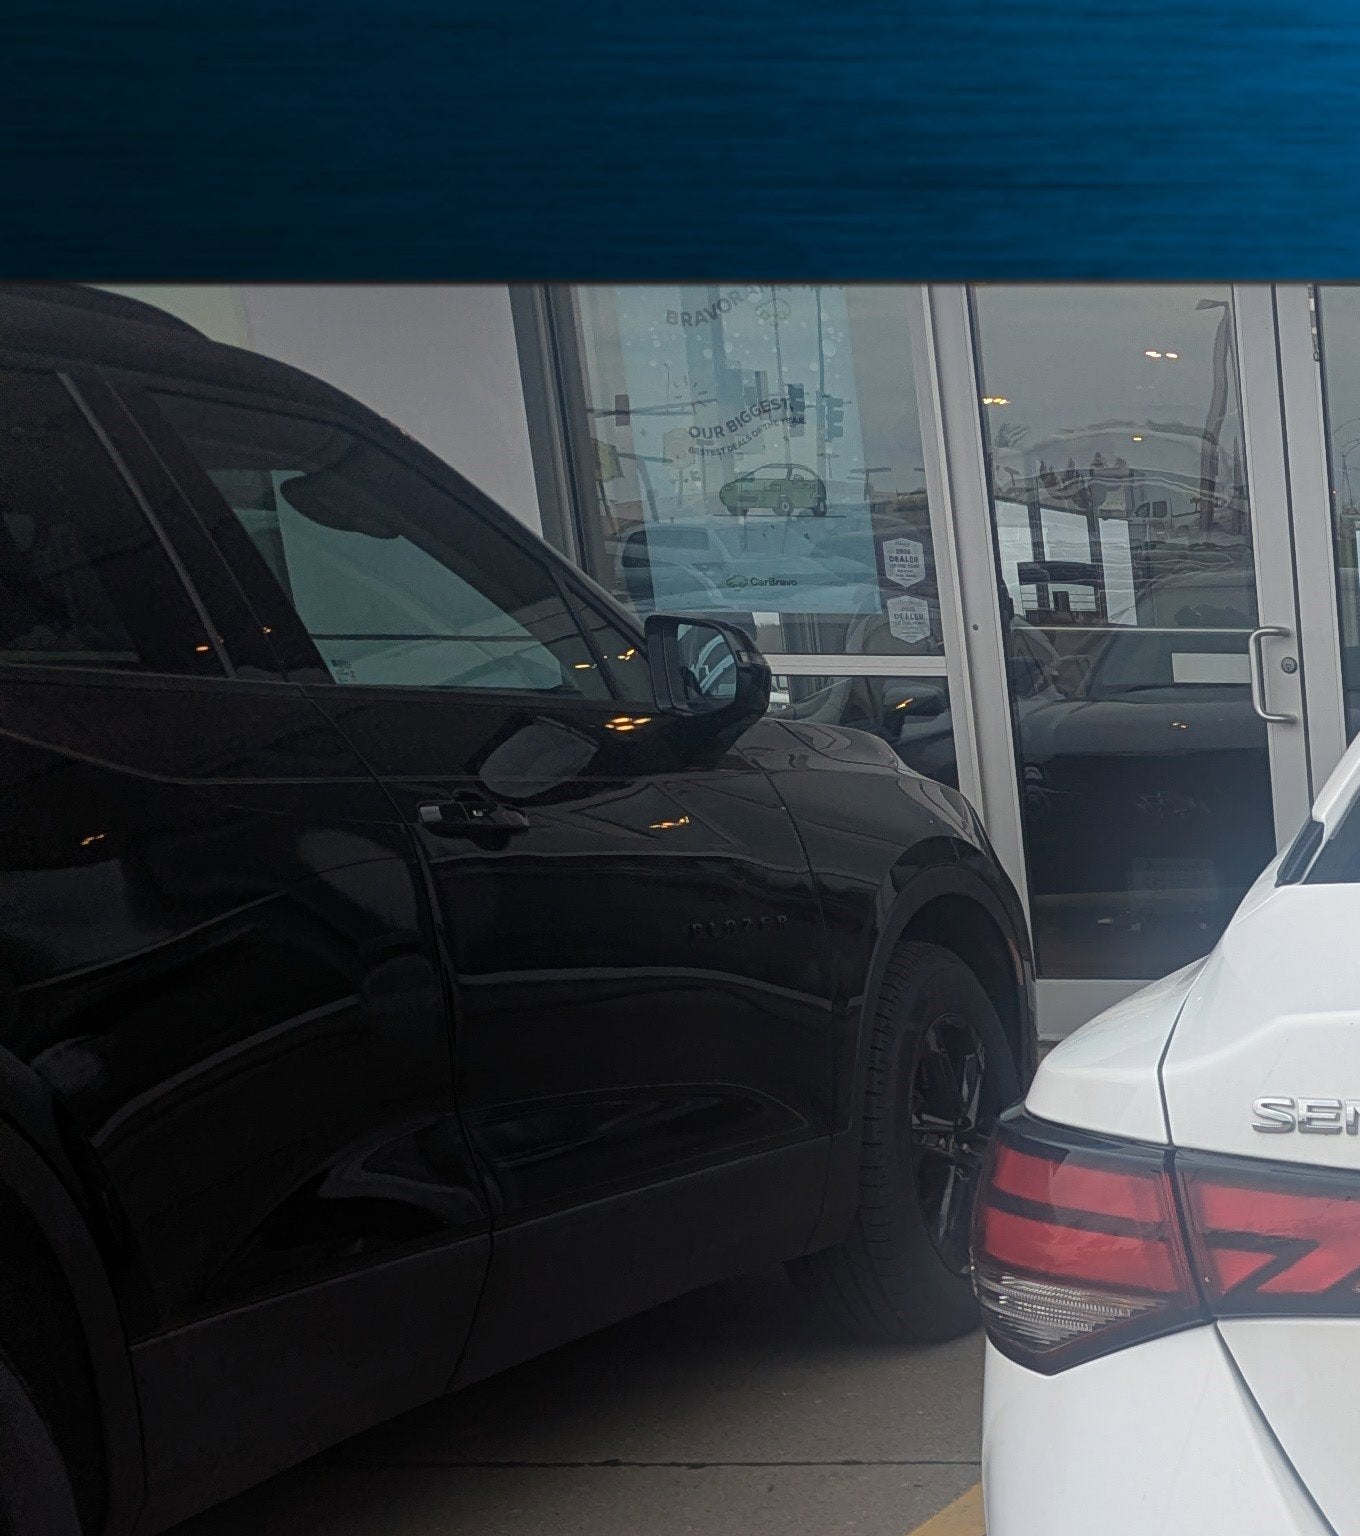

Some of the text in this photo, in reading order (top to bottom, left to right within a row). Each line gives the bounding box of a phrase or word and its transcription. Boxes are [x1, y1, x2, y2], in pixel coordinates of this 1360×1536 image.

[688, 425, 726, 439] OUR
[889, 555, 919, 563] DEALER
[750, 577, 798, 587] CarBravo
